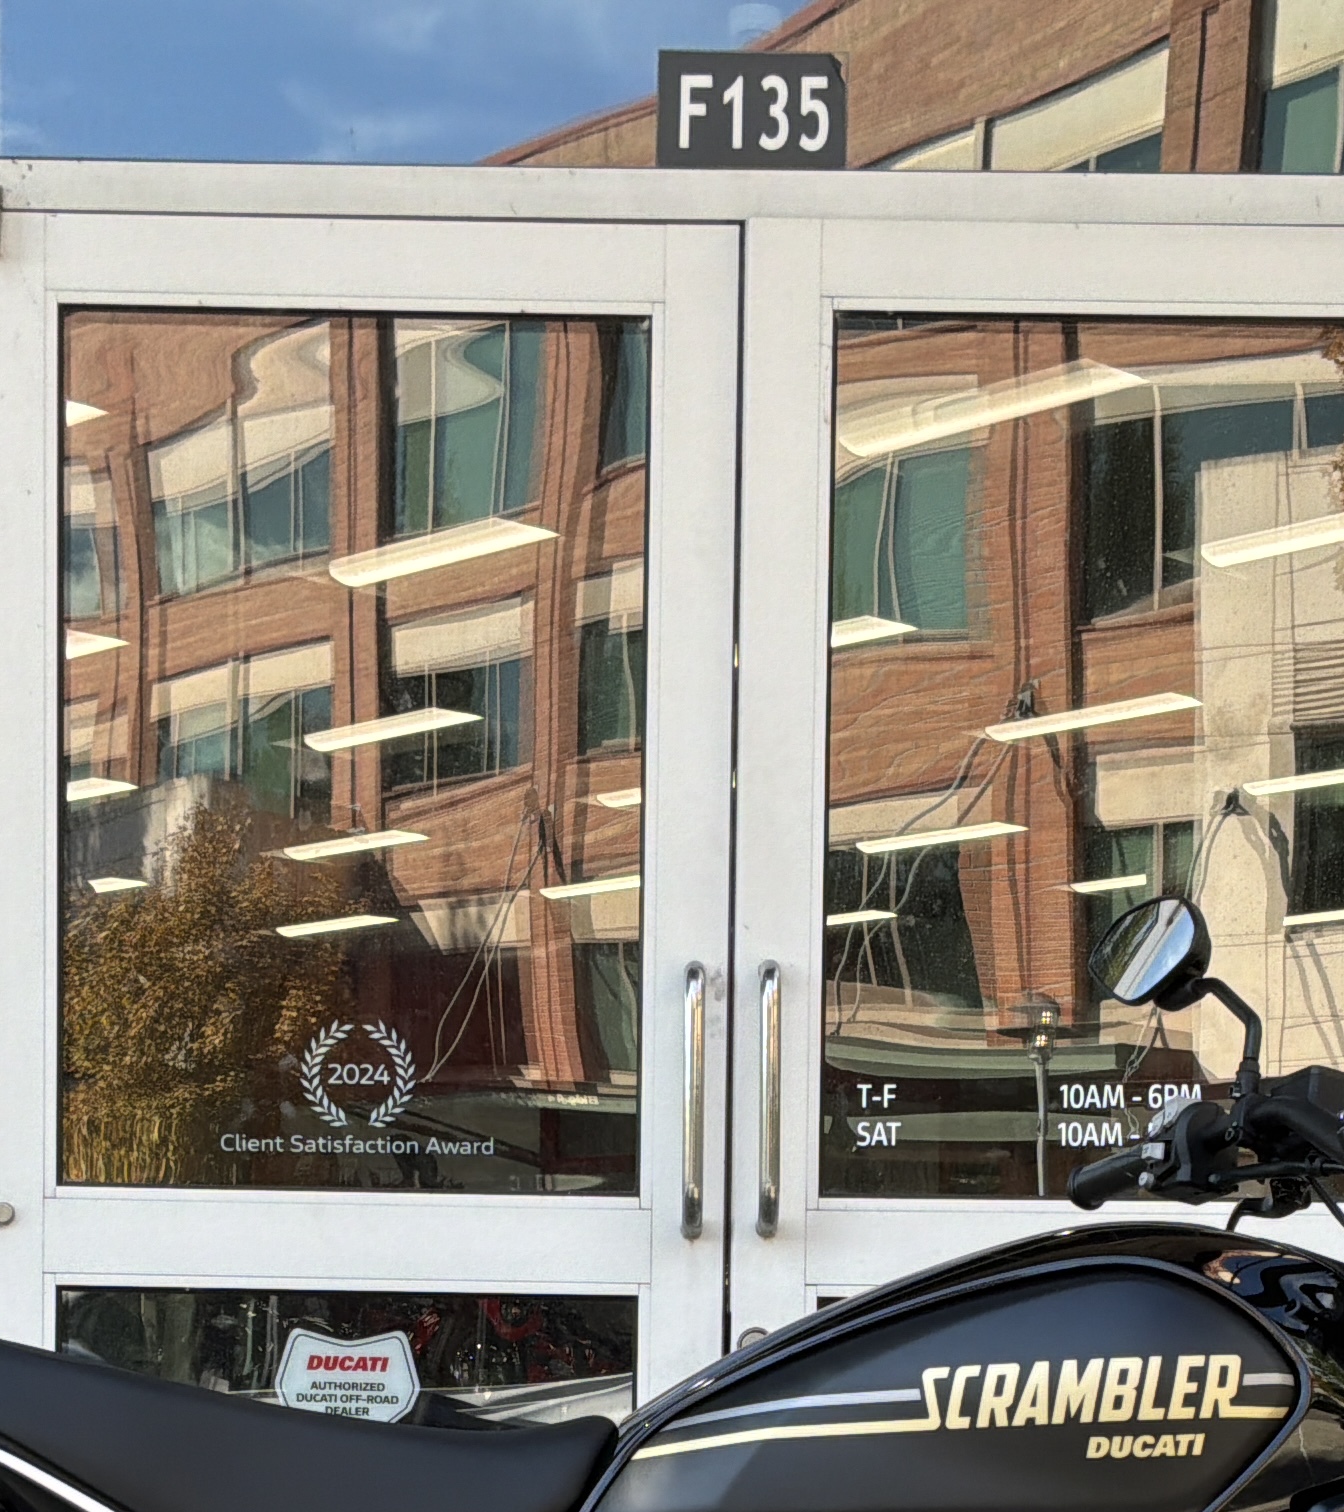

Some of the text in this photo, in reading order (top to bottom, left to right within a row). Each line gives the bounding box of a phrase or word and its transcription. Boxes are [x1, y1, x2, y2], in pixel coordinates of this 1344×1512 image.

[678, 74, 830, 152] F135
[327, 1063, 391, 1086] 2024
[856, 1084, 897, 1110] T-F
[1059, 1083, 1125, 1109] 10AM
[220, 1133, 495, 1155] Client Satisfaction Award
[856, 1121, 902, 1147] SAT
[1057, 1121, 1124, 1147] 10AM
[306, 1354, 390, 1373] DUCATI
[295, 1392, 400, 1406] DUCATI OFF-ROAD
[309, 1380, 386, 1393] AUTHORIZED
[920, 1354, 1243, 1432] SCRAMBLER
[324, 1405, 370, 1417] DEALER
[1085, 1432, 1206, 1459] DUCATI
